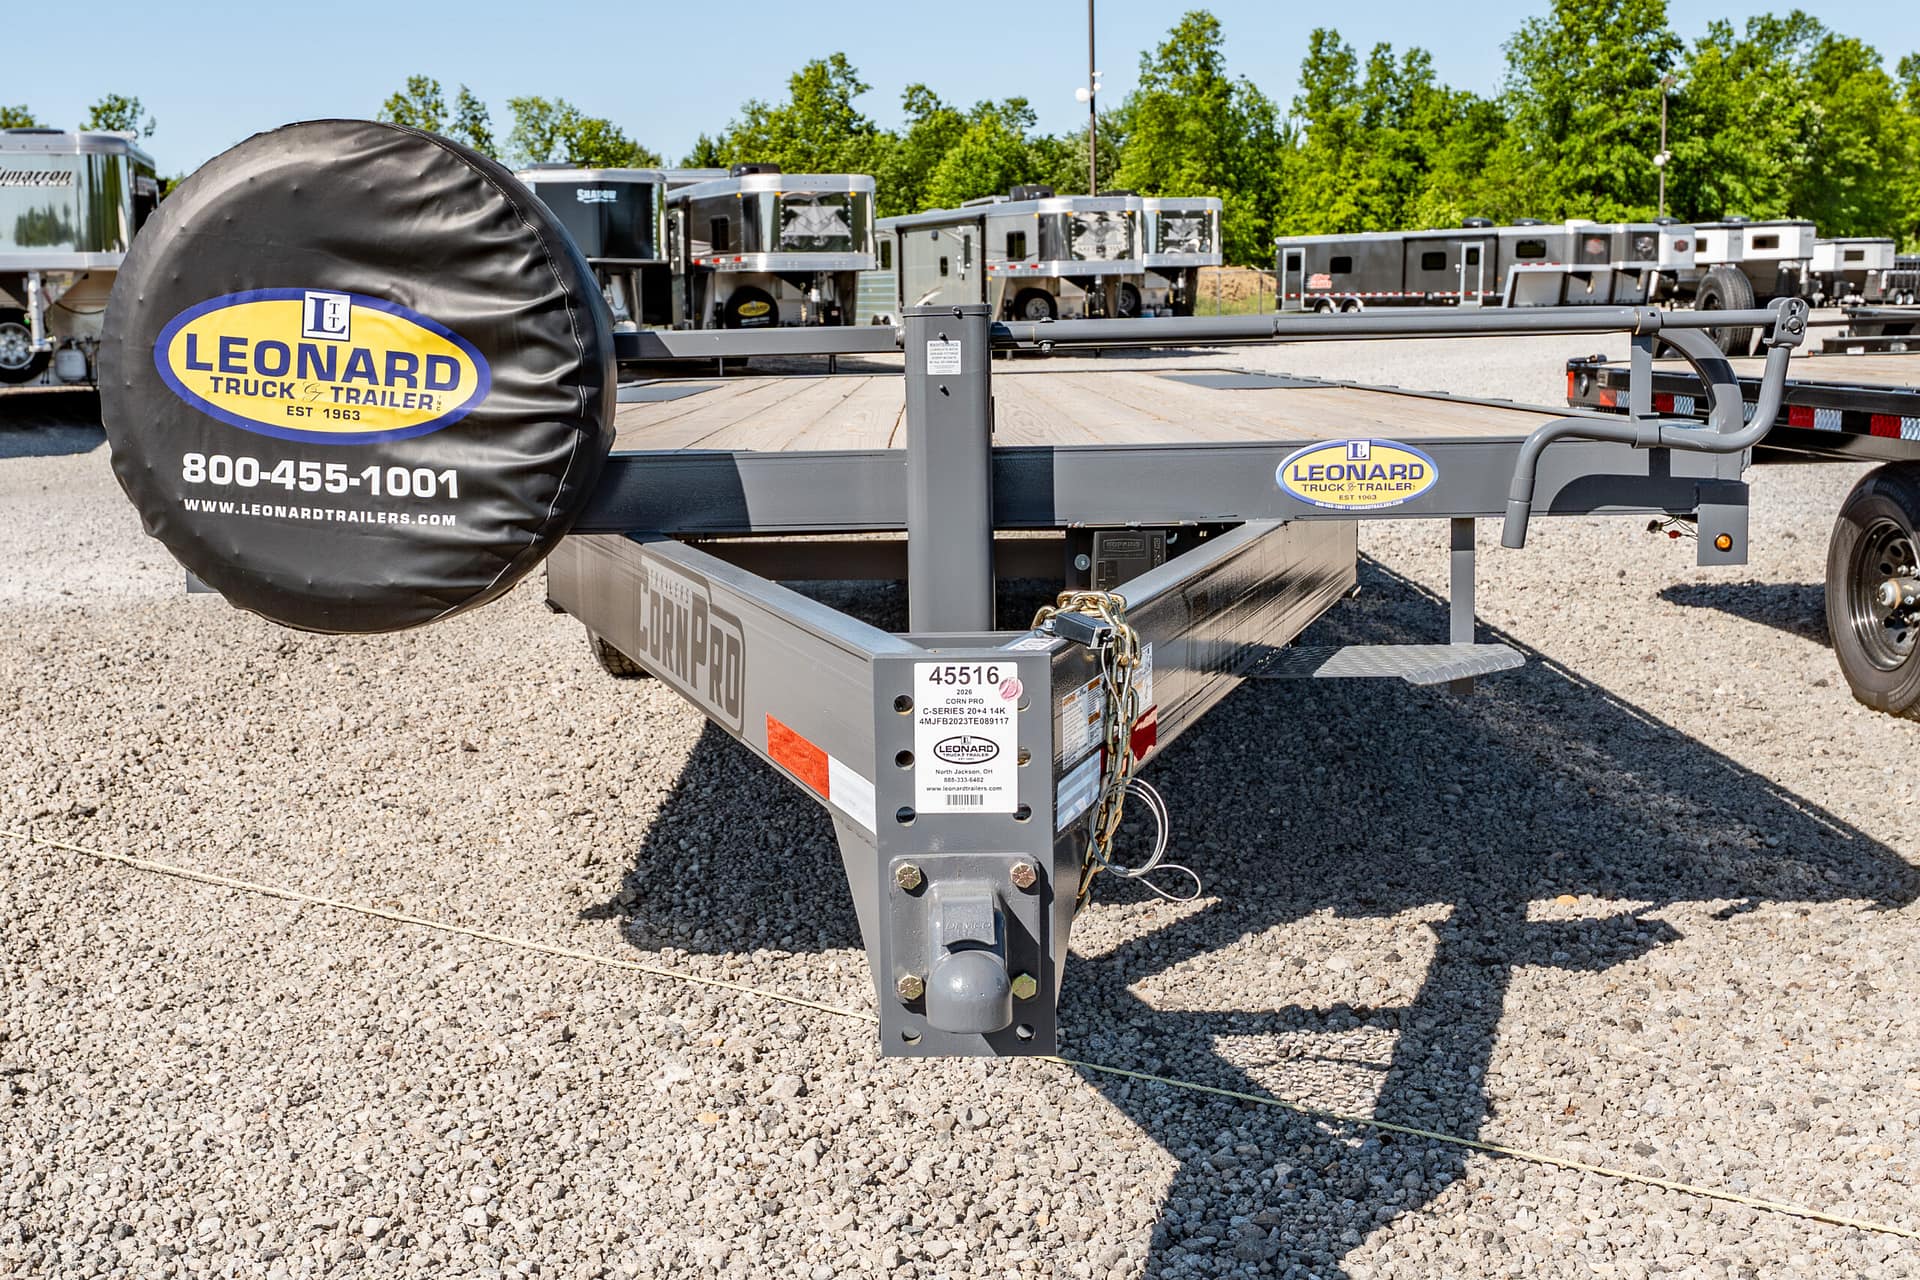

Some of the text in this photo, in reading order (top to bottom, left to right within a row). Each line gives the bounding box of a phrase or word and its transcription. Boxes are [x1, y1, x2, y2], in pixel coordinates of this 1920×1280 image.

[0, 167, 72, 182] imarron
[186, 333, 461, 392] LEONARD
[209, 376, 295, 399] TRUCK
[330, 386, 434, 410] TRAILER
[286, 405, 361, 421] EST 1963
[182, 453, 458, 498] 800-455-1001
[1293, 463, 1424, 481] LEONARD
[1302, 483, 1344, 492] TRUCK
[1355, 482, 1413, 491] TRAILER
[184, 499, 457, 526] WWW.LEONARDTRAILERS.COM
[929, 666, 999, 685] 45516
[923, 707, 1006, 715] C-SERIES 20+4 14K
[939, 745, 994, 753] LEONARD
